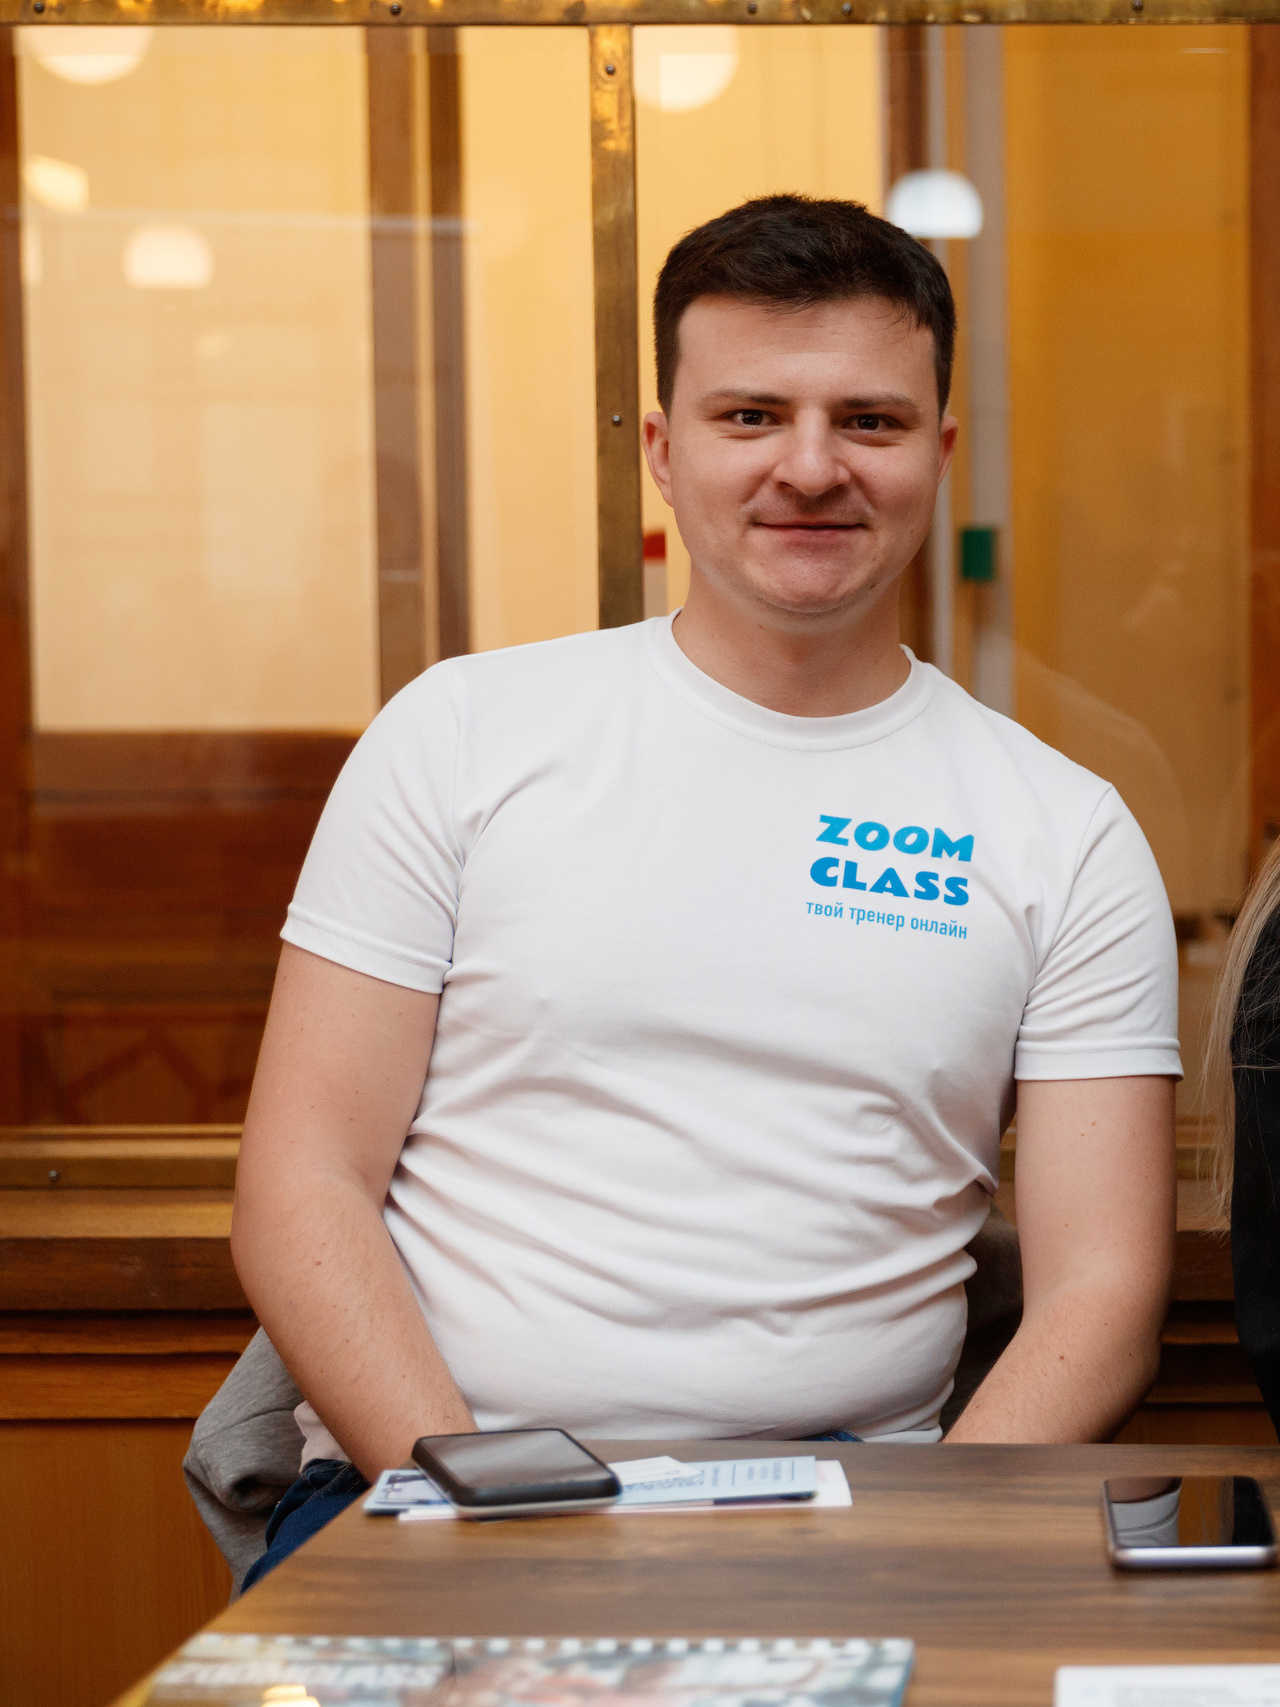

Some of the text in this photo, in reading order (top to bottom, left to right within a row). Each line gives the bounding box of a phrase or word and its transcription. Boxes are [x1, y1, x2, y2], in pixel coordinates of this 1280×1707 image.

[815, 814, 974, 862] ZOOM
[810, 857, 970, 907] CLASS
[806, 901, 968, 940] твой тренер онлайн
